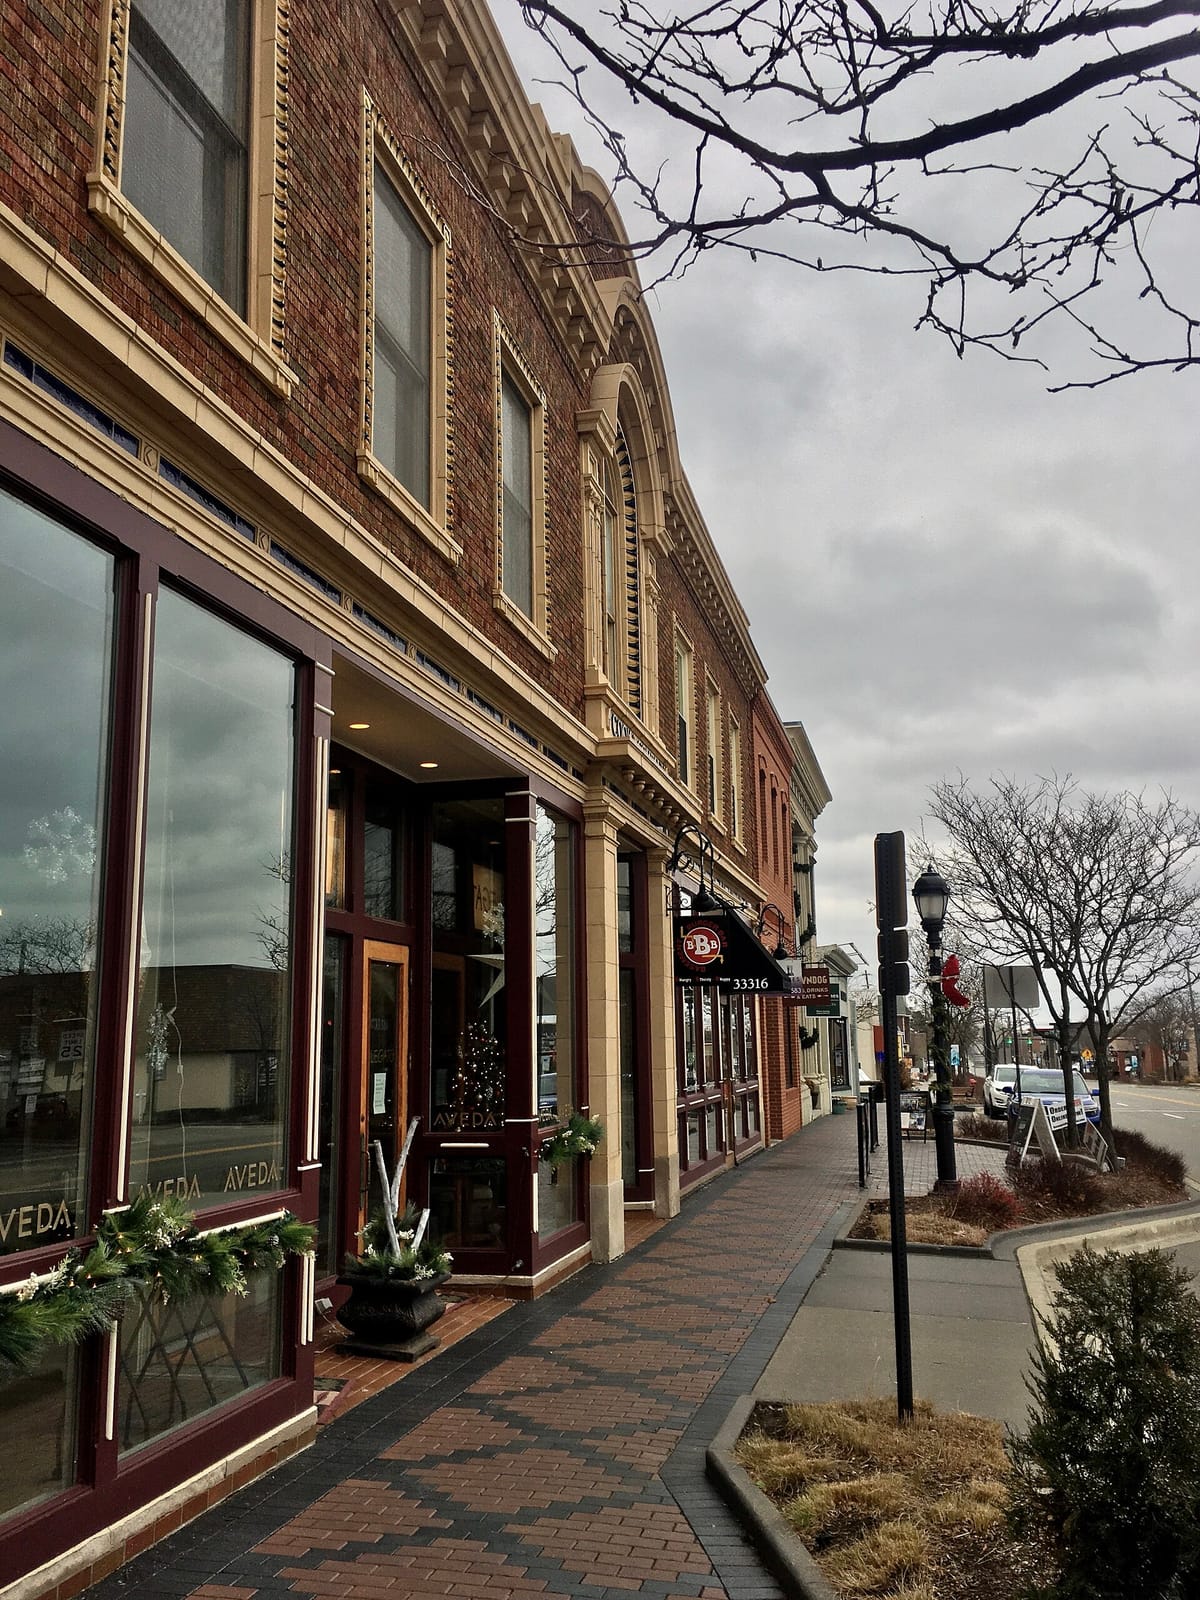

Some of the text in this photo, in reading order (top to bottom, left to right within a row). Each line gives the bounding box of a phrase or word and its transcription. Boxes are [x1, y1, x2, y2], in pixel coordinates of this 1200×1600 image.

[733, 977, 769, 990] 33316
[433, 1111, 497, 1127] AVEDA
[224, 1160, 279, 1193] AVEDA
[0, 1200, 71, 1242] VEDA
